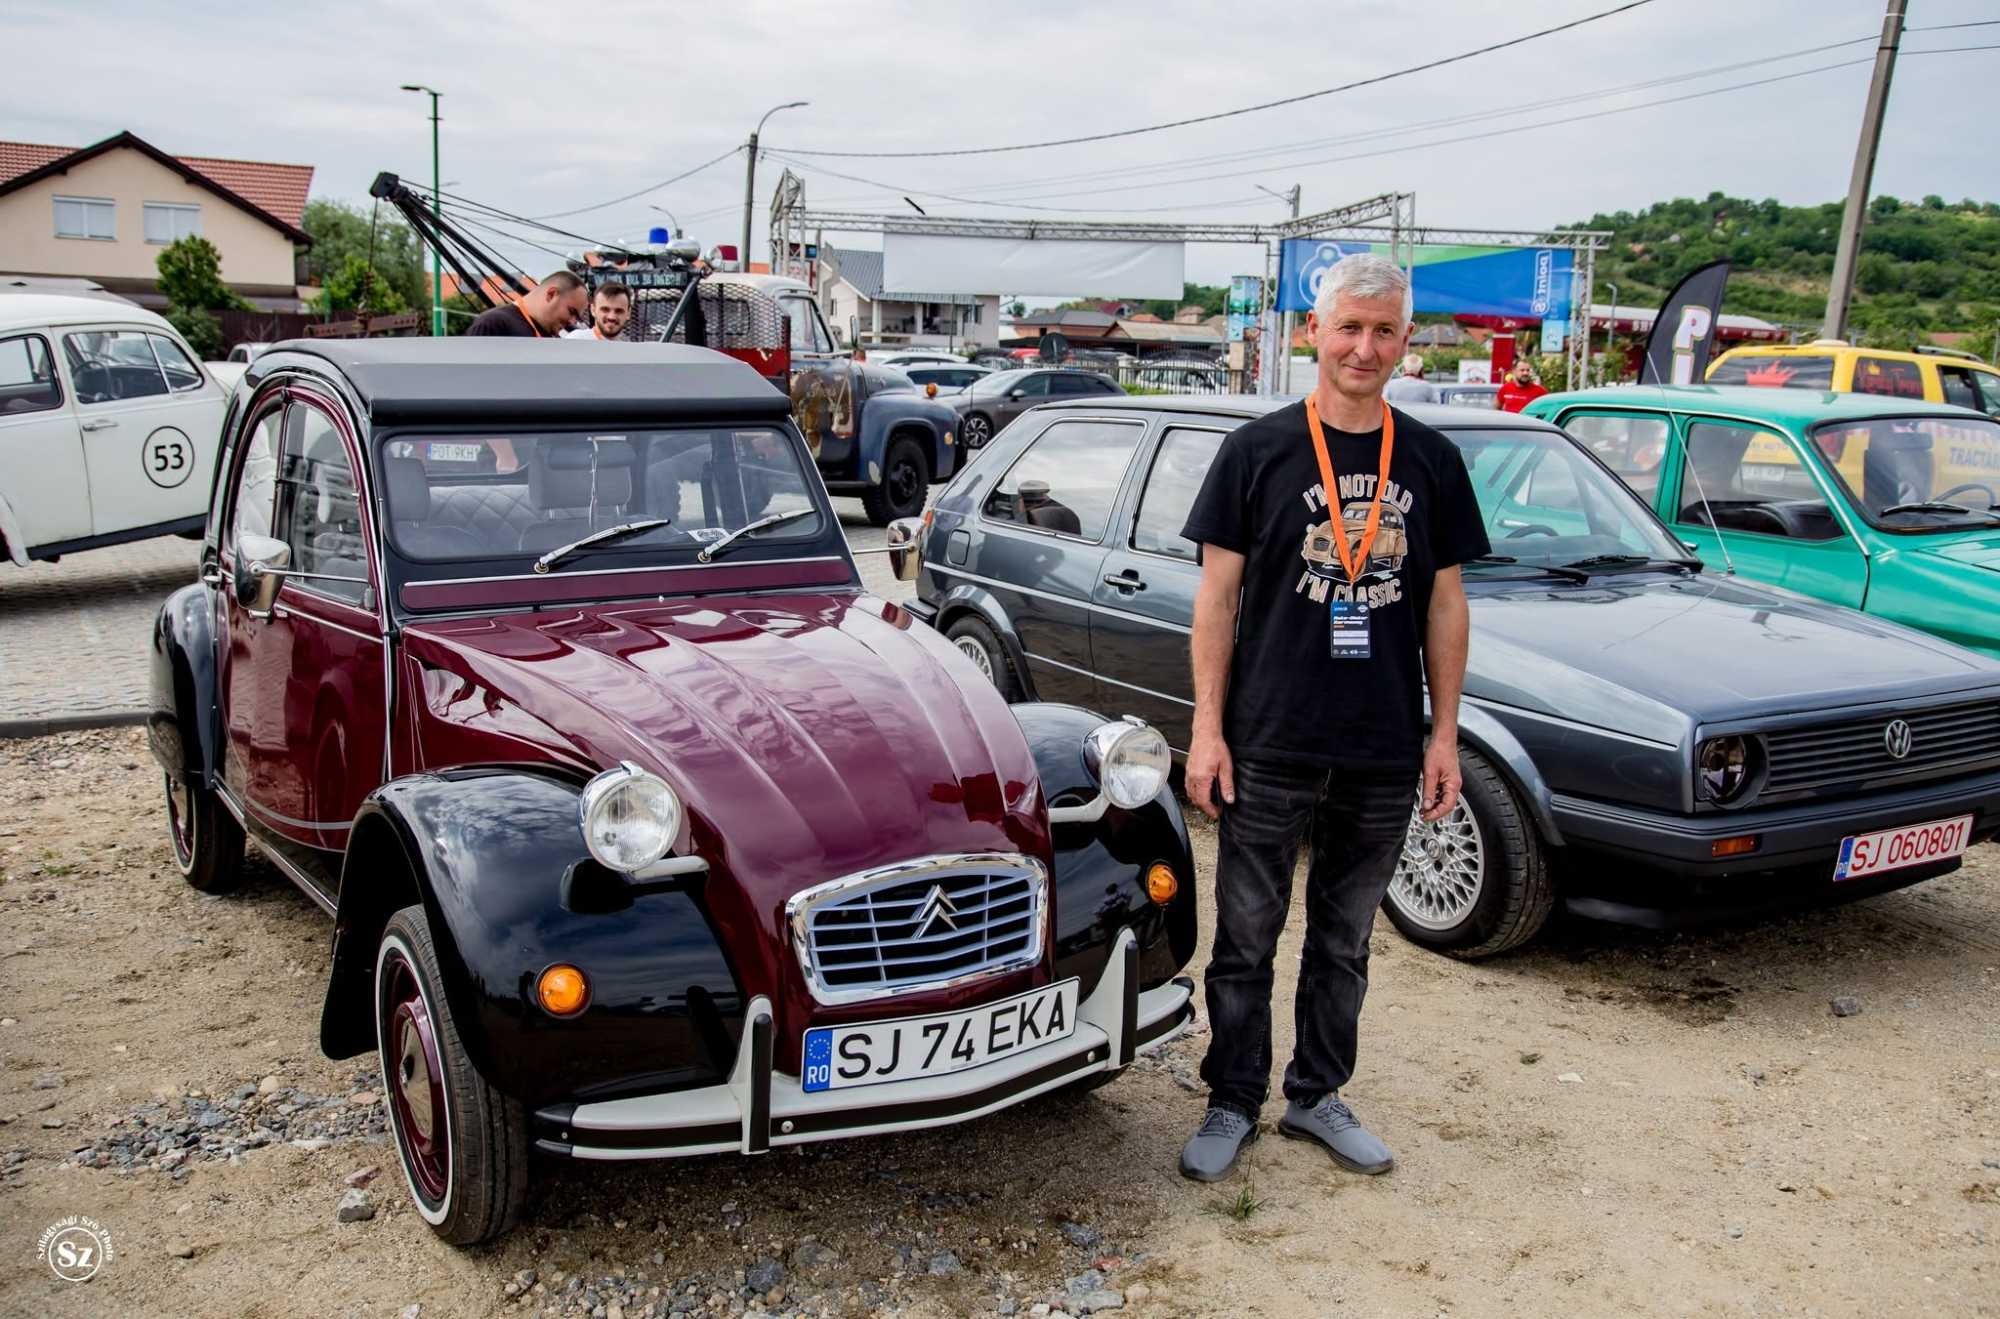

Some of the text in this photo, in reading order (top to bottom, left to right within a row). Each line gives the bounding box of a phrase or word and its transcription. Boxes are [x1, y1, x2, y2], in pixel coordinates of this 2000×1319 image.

[154, 443, 184, 472] 53
[1338, 473, 1378, 500] NOT
[1381, 479, 1413, 514] OLD
[1295, 571, 1330, 603] I'M
[1851, 836, 1884, 872] SJ
[1887, 821, 1965, 865] 060801
[806, 989, 1065, 1085] RO SJ 74 EKA
